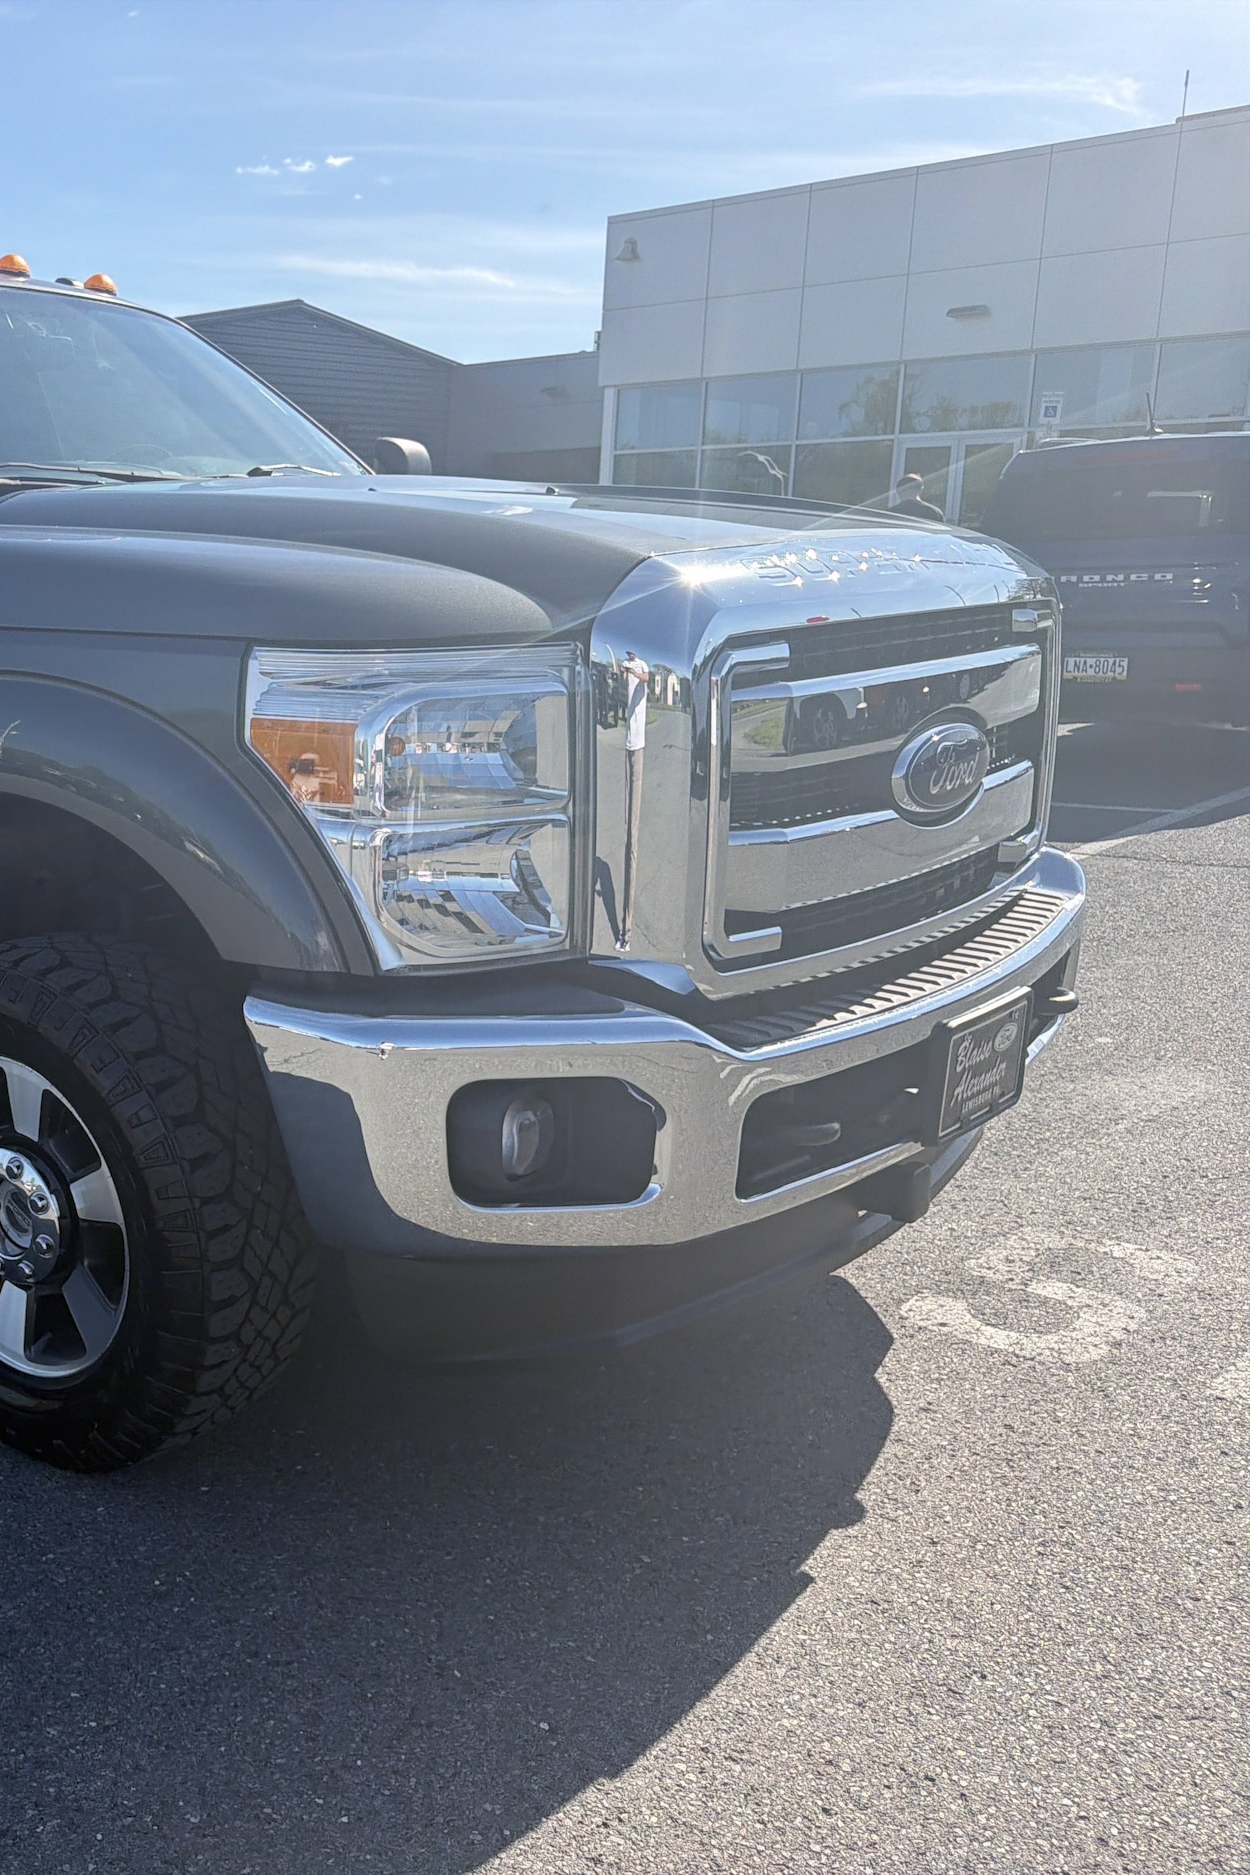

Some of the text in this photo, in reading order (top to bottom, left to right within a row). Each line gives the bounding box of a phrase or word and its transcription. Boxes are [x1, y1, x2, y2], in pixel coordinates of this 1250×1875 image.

[1060, 572, 1174, 583] RONCO
[930, 739, 979, 794] Ford
[956, 1039, 993, 1073] Blaise
[950, 1055, 1007, 1107] Alexander
